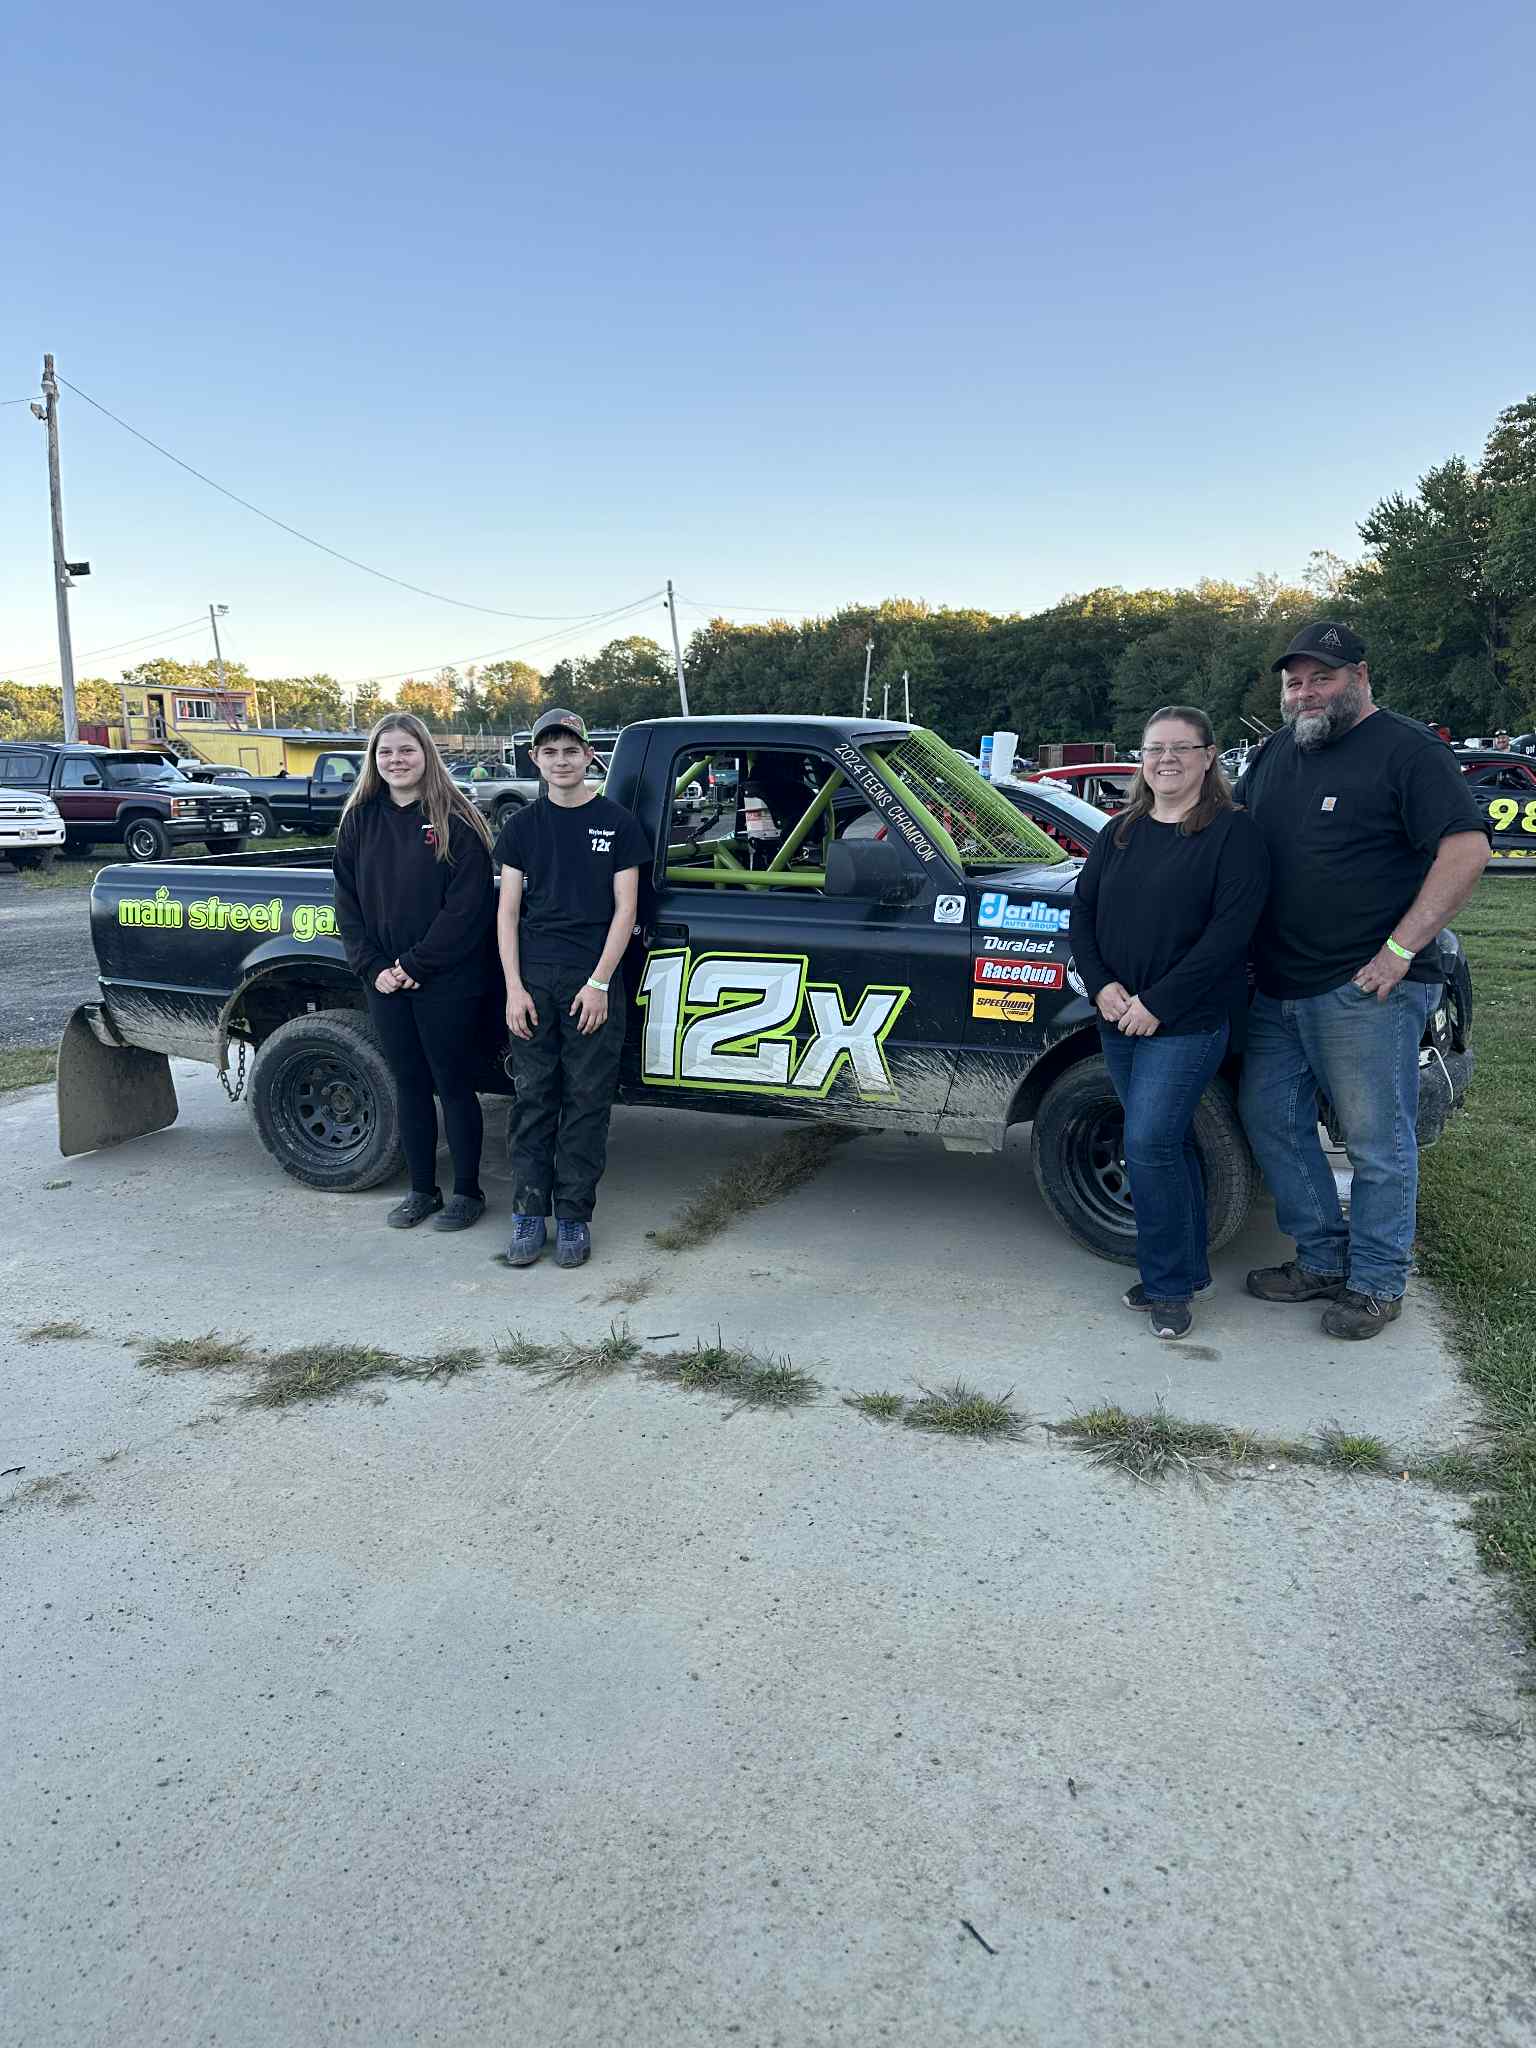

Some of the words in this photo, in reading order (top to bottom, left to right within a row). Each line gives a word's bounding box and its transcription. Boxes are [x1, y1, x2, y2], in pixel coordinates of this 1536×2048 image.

[834, 743, 867, 775] 2024
[859, 770, 893, 807] TEENS
[887, 806, 937, 862] CHAMPION
[118, 886, 183, 929] main
[188, 896, 284, 932] street
[291, 904, 342, 942] ga
[1004, 919, 1025, 928] AUTO
[1028, 920, 1057, 930] GROUP
[983, 935, 1055, 954] Duralast
[981, 961, 1057, 985] RaceQuip
